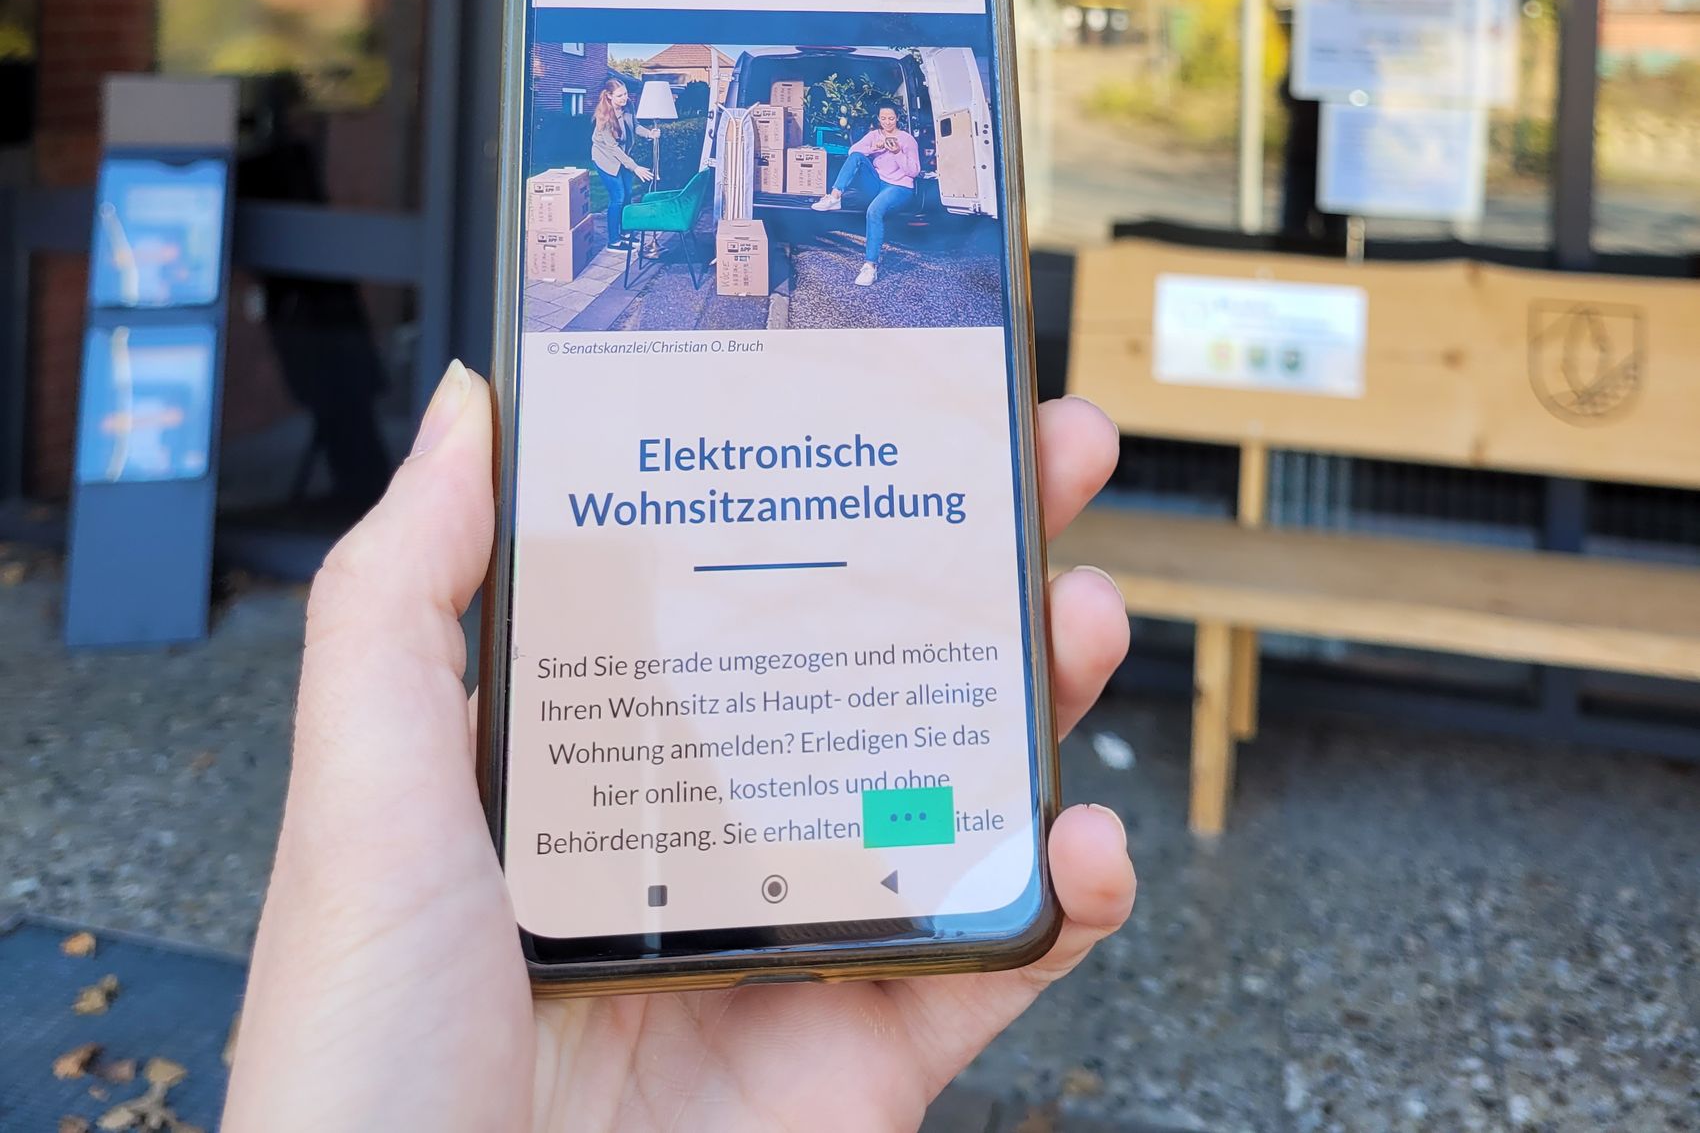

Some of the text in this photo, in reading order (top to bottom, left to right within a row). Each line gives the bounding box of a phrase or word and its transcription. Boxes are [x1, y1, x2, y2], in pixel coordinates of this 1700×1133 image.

[562, 341, 707, 354] Senatskanzlei/Christian
[711, 341, 724, 352] O.
[728, 340, 763, 352] Bruch
[640, 434, 898, 472] Elektronische
[568, 484, 966, 527] Wohnsitzanmeldung
[538, 642, 997, 680] Sind Sie gerade umgezogen und möchten
[542, 682, 997, 722] Ihren Wohnsitz als Haupt- oder alleinige
[549, 724, 990, 765] Wohnung anmelden? Erledigen Sie das
[593, 770, 952, 807] hier online, kostenlos und ohne
[537, 809, 1004, 855] Behördengang. Sie erhalten itale
